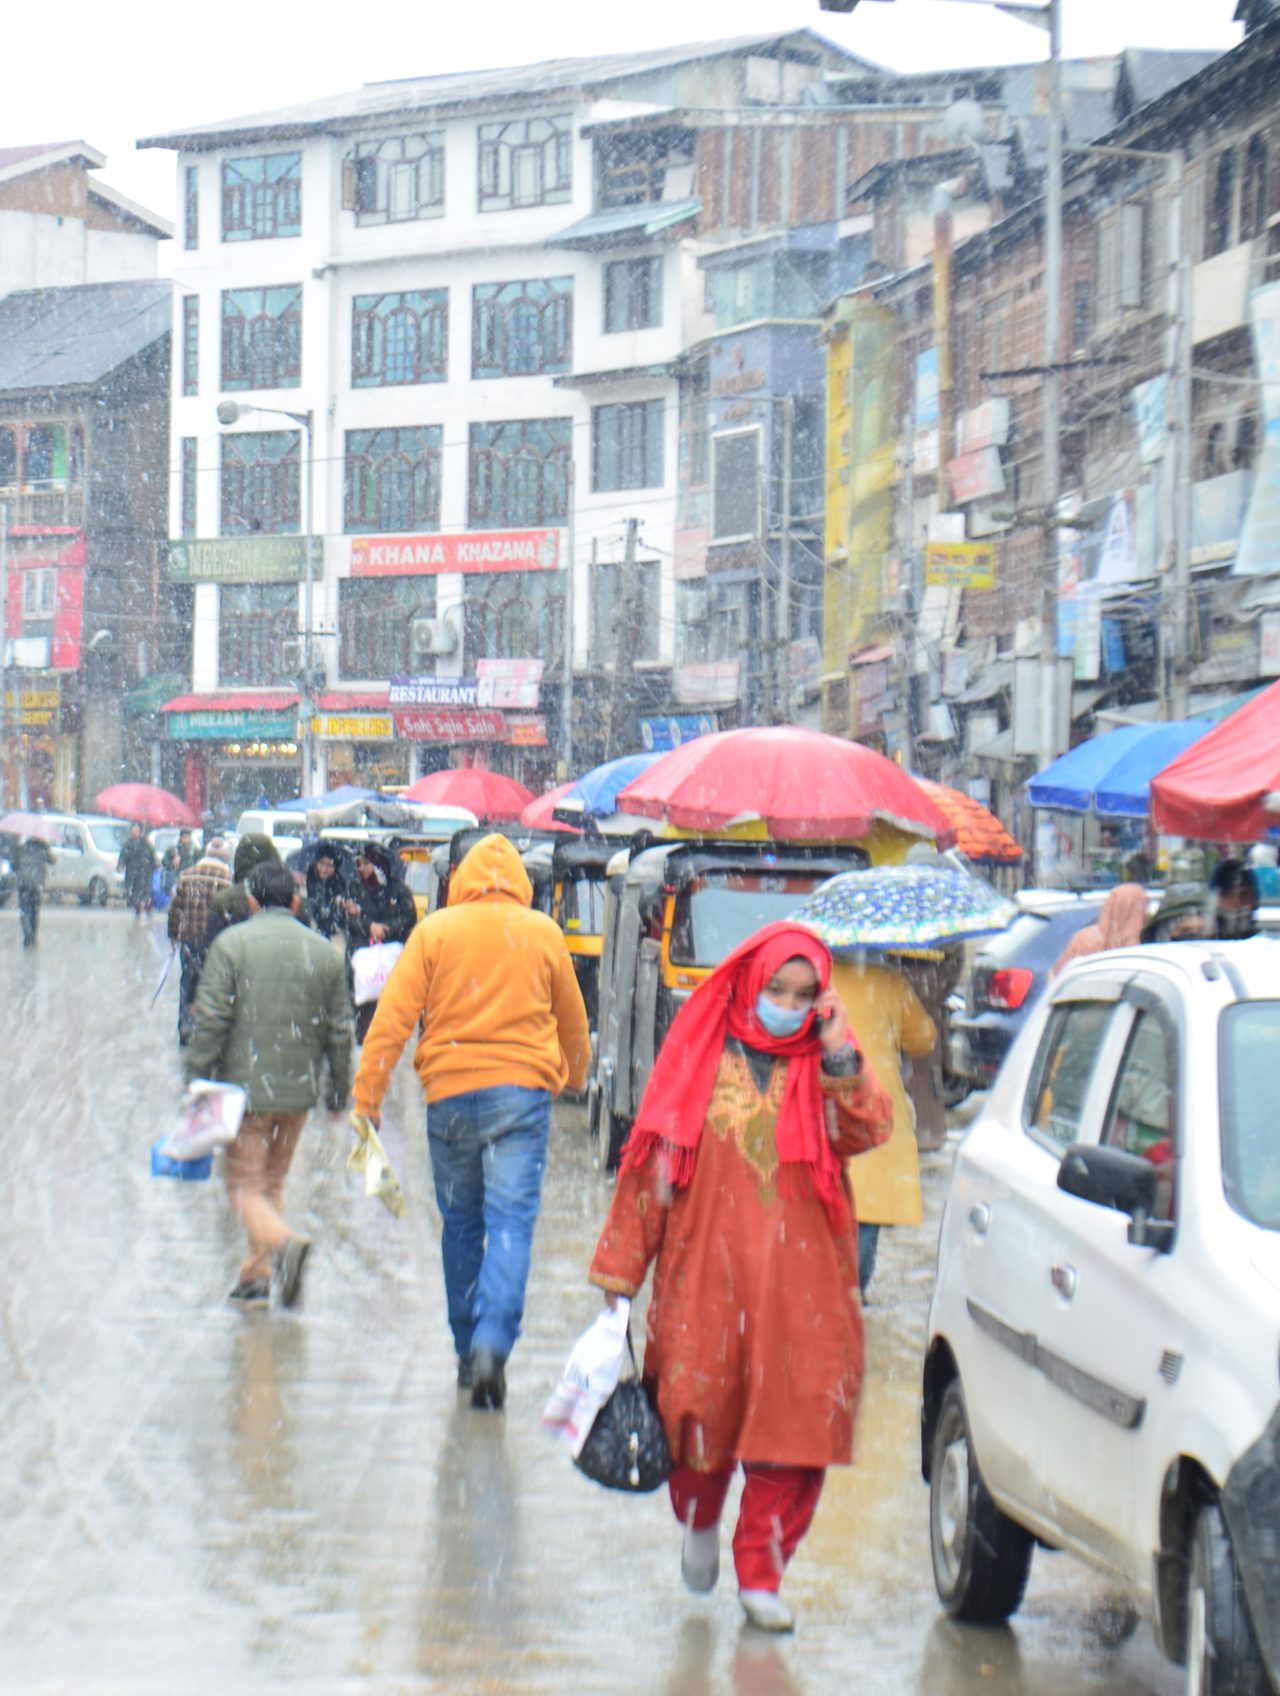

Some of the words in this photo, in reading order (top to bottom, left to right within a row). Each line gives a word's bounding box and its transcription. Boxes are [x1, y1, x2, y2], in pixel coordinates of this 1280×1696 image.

[371, 543, 445, 566] KHANA
[456, 539, 537, 563] KHAZANA
[389, 684, 477, 704] RESTAURANT
[404, 717, 431, 733] Sale
[433, 717, 463, 736] Sale
[468, 718, 496, 735] Sale
